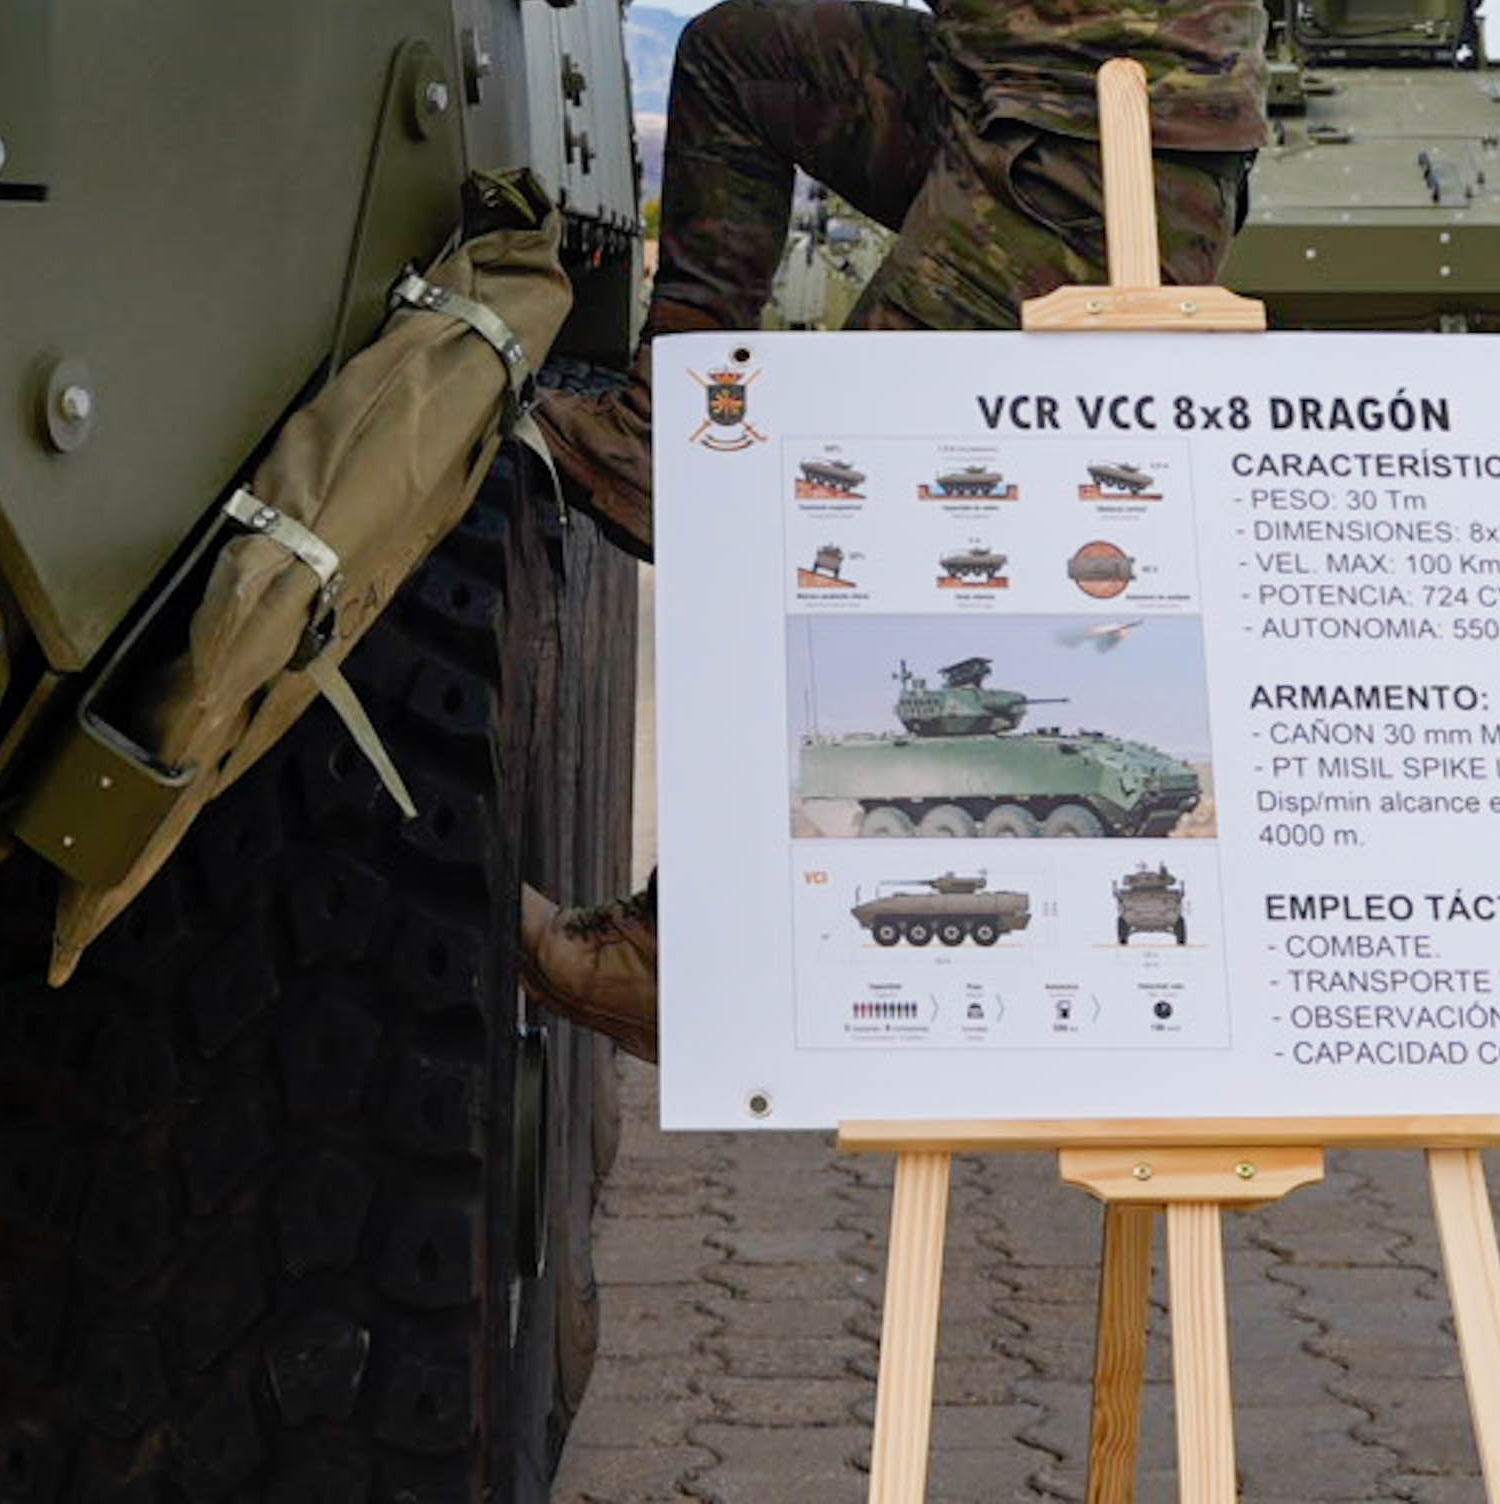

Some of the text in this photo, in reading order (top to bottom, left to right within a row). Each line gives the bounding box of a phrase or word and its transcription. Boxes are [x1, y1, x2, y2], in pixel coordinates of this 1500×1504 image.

[977, 388, 1450, 432] VCR VCC 8x8 DRAGÓN
[1251, 488, 1336, 510] PESO:
[1346, 489, 1377, 510] 30
[1385, 489, 1427, 510] Tm
[1254, 520, 1461, 543] DIMENSIONES:
[1256, 552, 1316, 574] VEL.
[1327, 553, 1394, 573] MAX:
[1407, 554, 1452, 574] 100
[1259, 584, 1412, 606] POTENCIA:
[1423, 585, 1469, 607] 724
[1262, 617, 1440, 639] AUTONOMIA:
[1452, 618, 1499, 641] 550
[1251, 685, 1488, 710] ARMAMENTO:
[1270, 718, 1374, 744] CAÑON
[1383, 723, 1416, 746] 30
[1424, 728, 1472, 744] mm
[1272, 757, 1308, 778] PT
[1318, 757, 1393, 779] MISIL
[1402, 757, 1487, 780] SPIKE
[1257, 790, 1371, 817] Disp/min
[1380, 791, 1480, 814] alcance
[1259, 824, 1364, 847] 4000 m.
[1266, 895, 1413, 921] EMPLEO
[1285, 935, 1439, 958] COMBATE.
[1288, 969, 1492, 993] TRANSPORTE
[1293, 1041, 1468, 1065] CAPACIDAD
